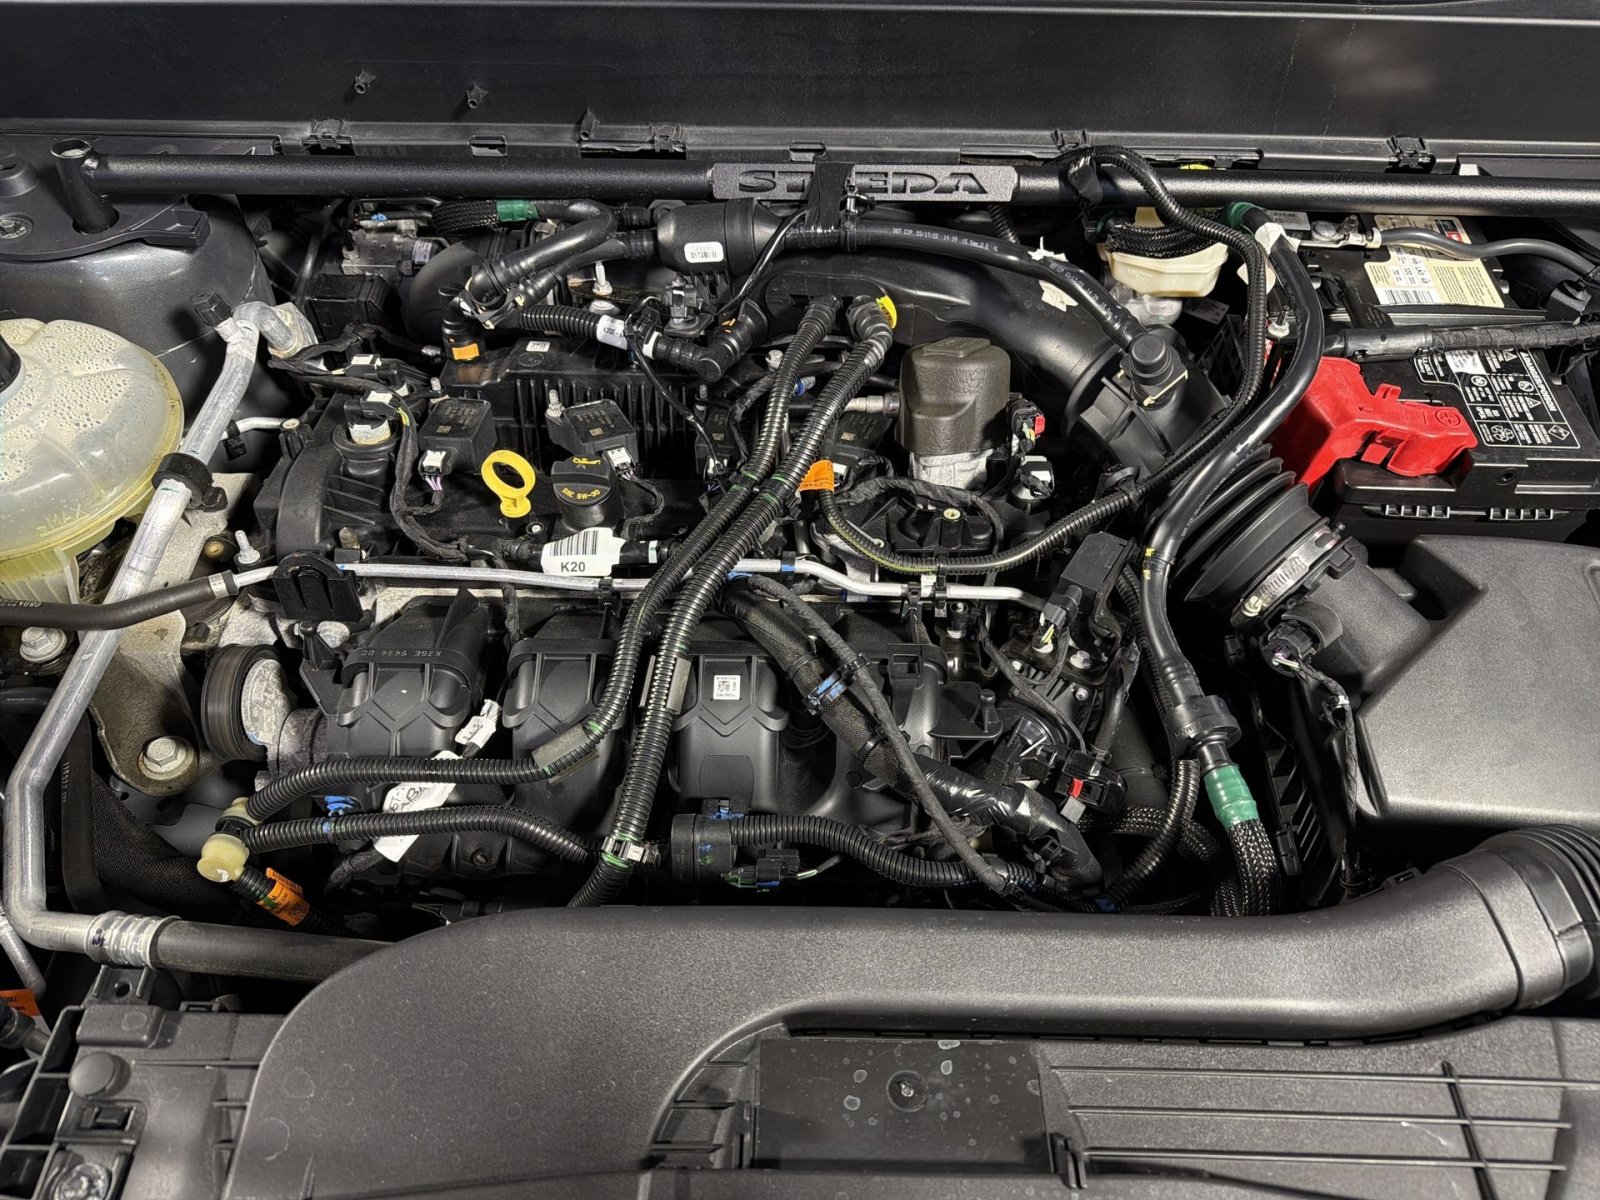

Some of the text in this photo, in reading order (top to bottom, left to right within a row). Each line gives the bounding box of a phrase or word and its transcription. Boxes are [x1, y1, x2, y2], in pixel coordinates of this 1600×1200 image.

[738, 170, 988, 194] STEDA
[562, 487, 601, 500] SAE 5W-30
[561, 561, 586, 572] K20
